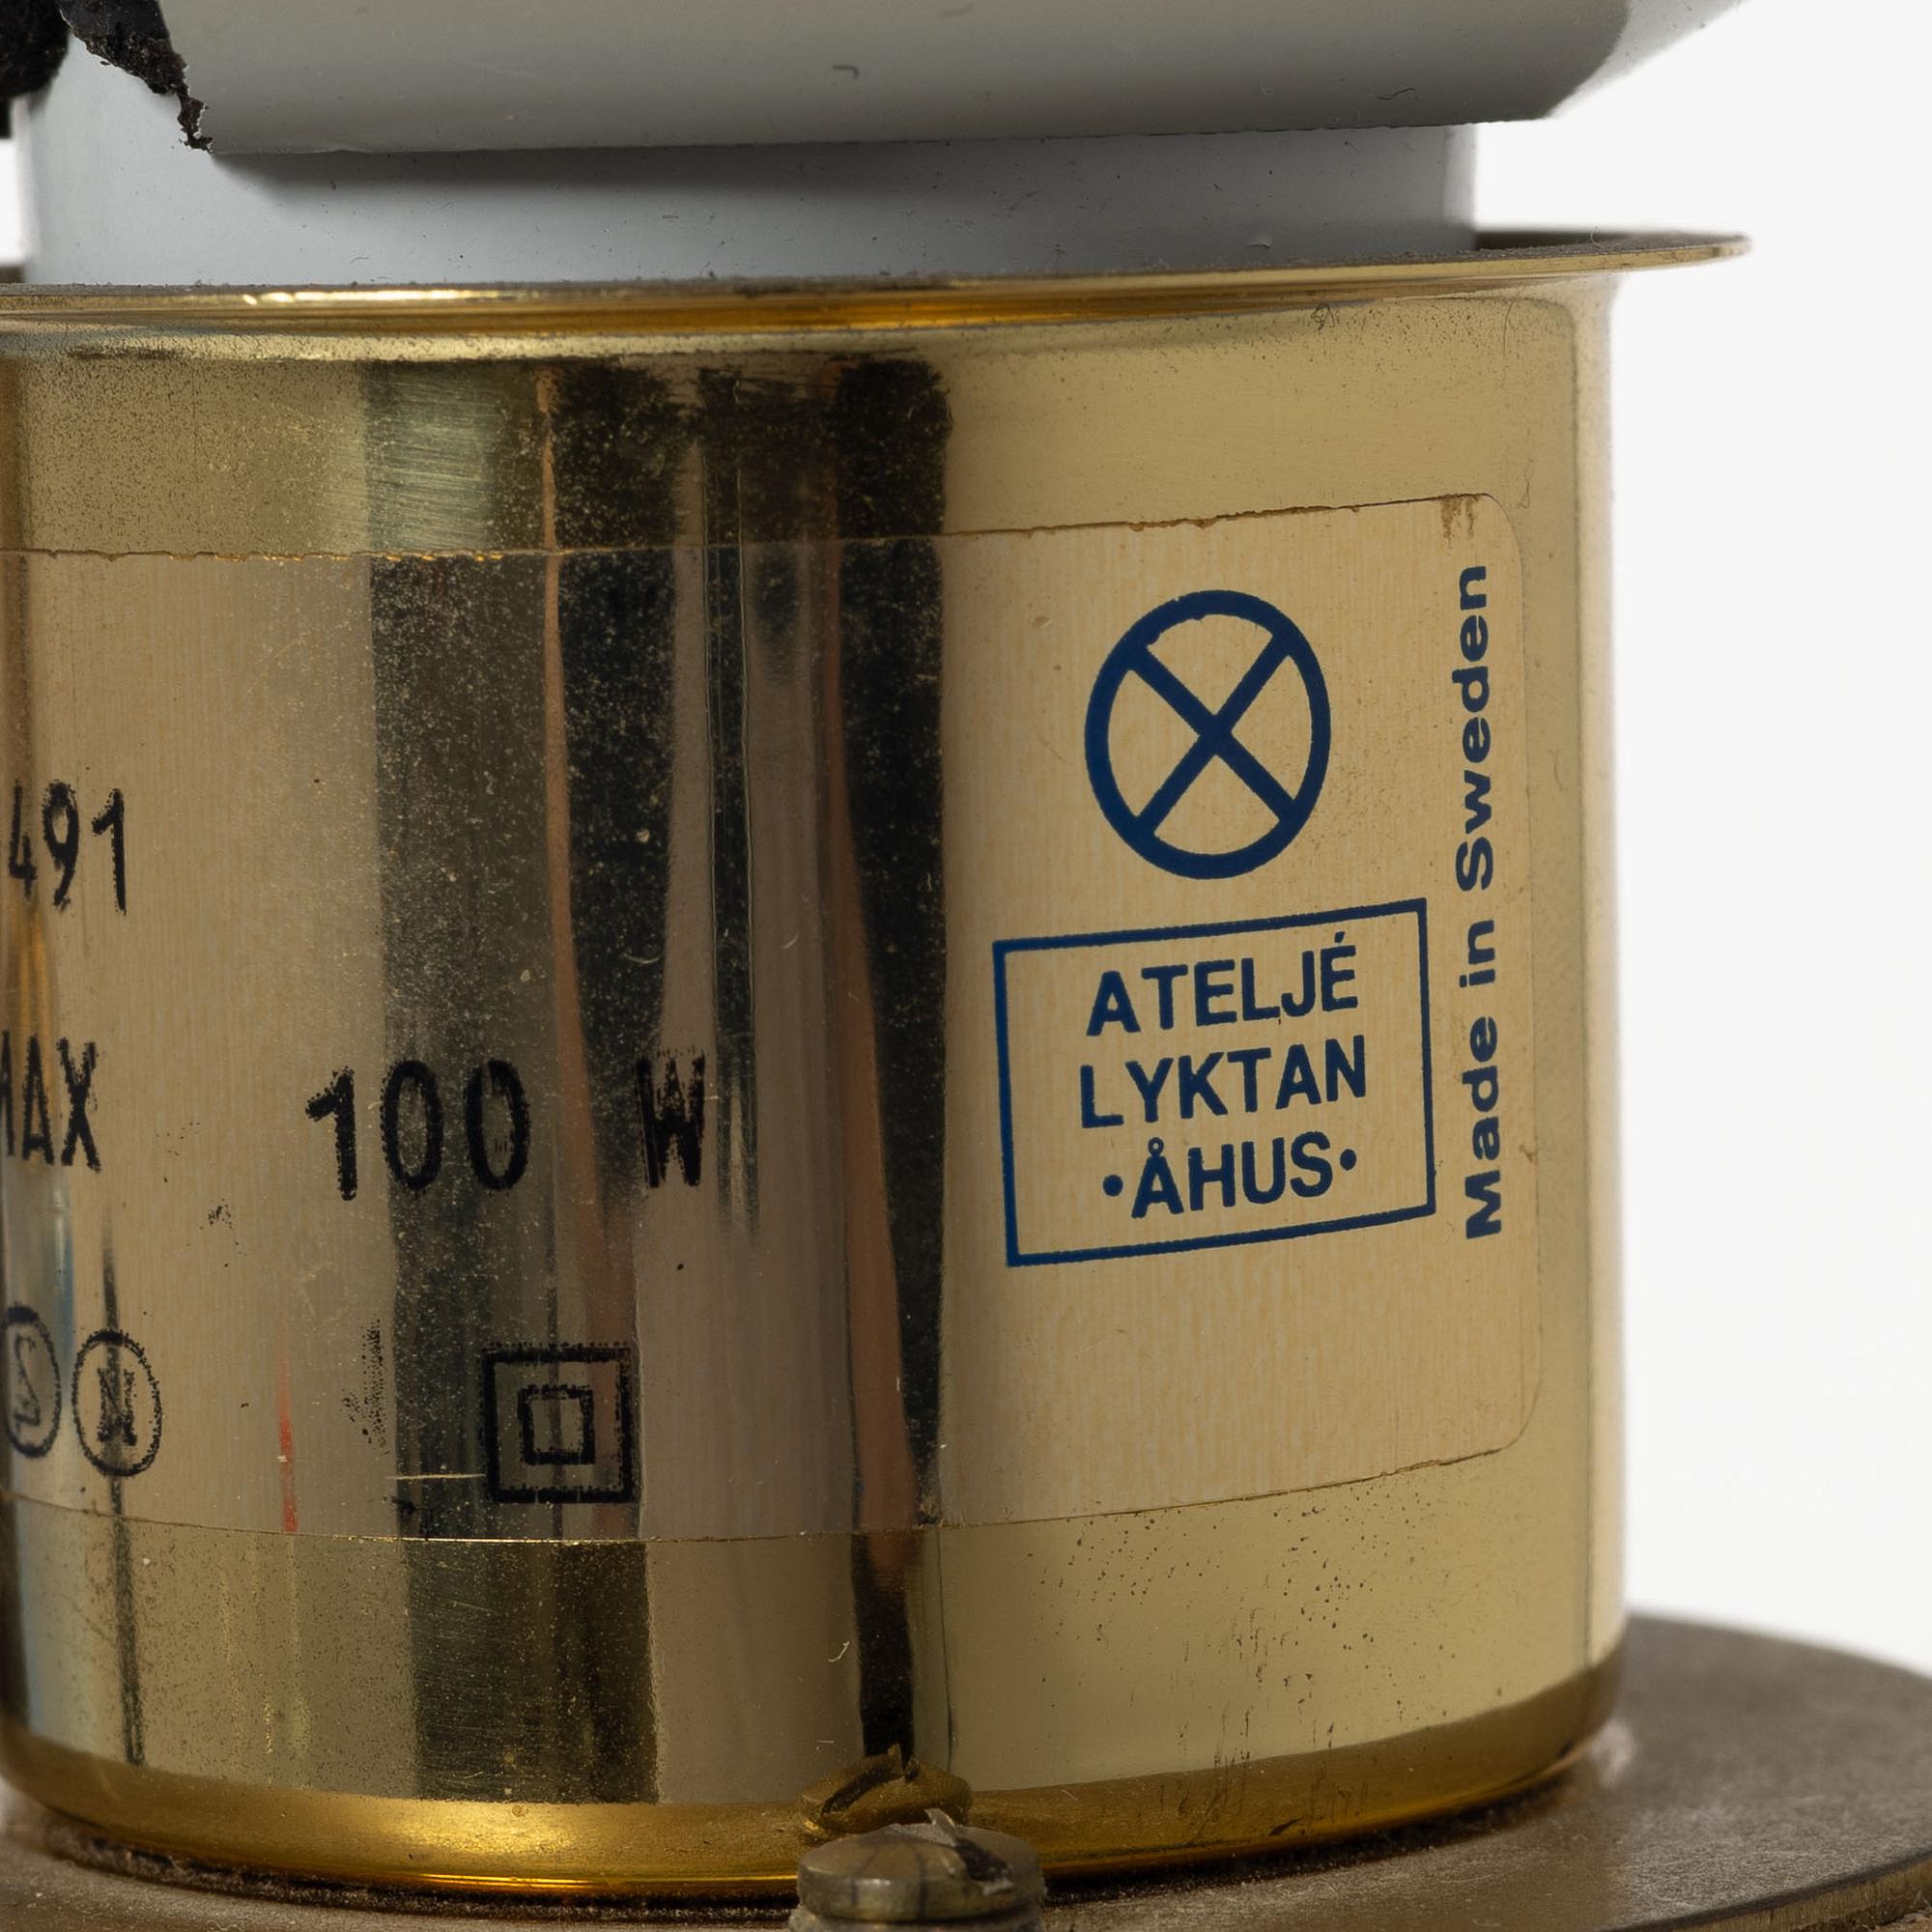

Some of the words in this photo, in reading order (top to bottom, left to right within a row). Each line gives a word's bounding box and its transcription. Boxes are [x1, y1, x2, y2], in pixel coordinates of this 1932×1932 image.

[1452, 565, 1494, 891] Sweden
[1086, 931, 1358, 1037] ATELJÉ
[1460, 920, 1495, 988] in
[304, 1059, 530, 1201] 100
[636, 1049, 705, 1189] W
[1080, 1035, 1367, 1128] LYKTAN
[1463, 1016, 1502, 1239] Made
